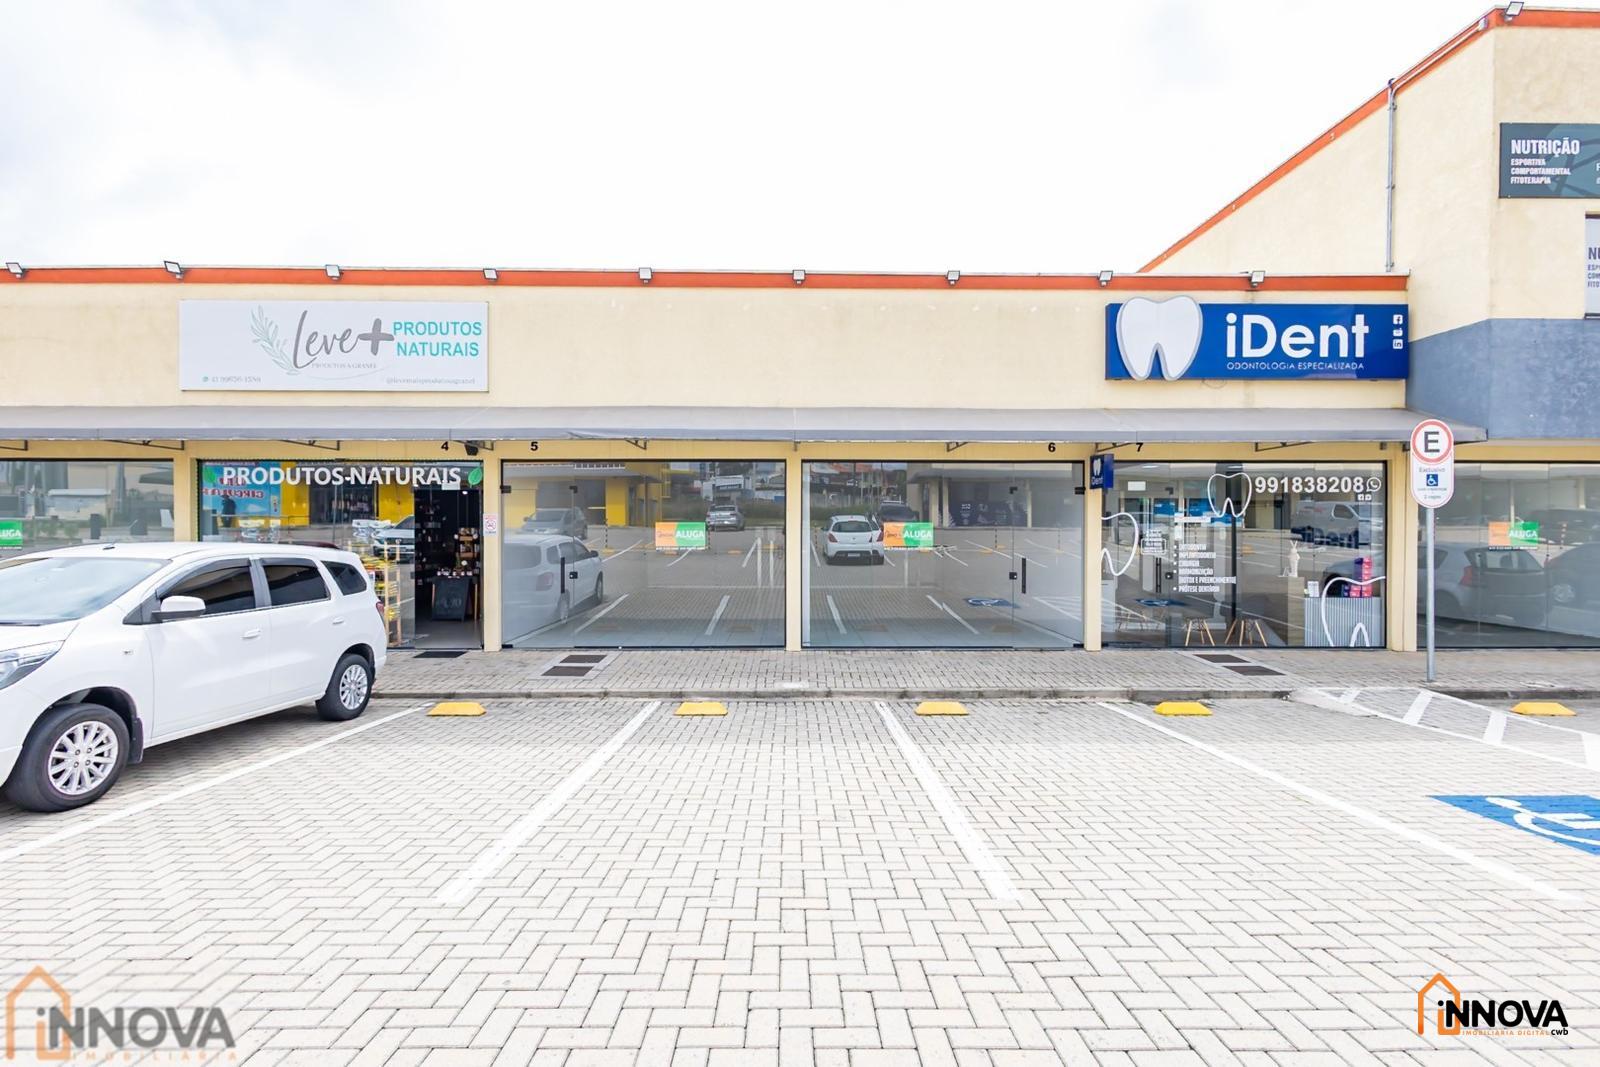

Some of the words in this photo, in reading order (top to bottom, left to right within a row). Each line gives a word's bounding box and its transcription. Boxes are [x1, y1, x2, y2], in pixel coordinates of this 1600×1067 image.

[1510, 136, 1580, 157] NUTRIÇÃO
[1510, 158, 1546, 166] ESPORTIVA
[1510, 167, 1571, 175] COMPORTAMENTAL
[1510, 176, 1551, 185] FITOTERAPIA
[393, 321, 482, 336] PRODUTOS
[1226, 312, 1370, 358] iDent
[396, 341, 479, 357] NATURAIS
[1226, 362, 1295, 370] ODONTOLOGIA
[1298, 362, 1364, 370] ESPECIALIZADA
[441, 441, 449, 451] 4
[530, 441, 538, 451] 5
[1424, 431, 1440, 453] E
[1048, 442, 1056, 453] 6
[1136, 442, 1143, 453] 7
[223, 467, 344, 485] PRODUTOS
[350, 467, 461, 485] NATURAIS
[1254, 476, 1364, 493] 991838208
[676, 529, 705, 538] ALUGA
[903, 529, 933, 538] ALUGA
[1509, 529, 1537, 538] ALUGA
